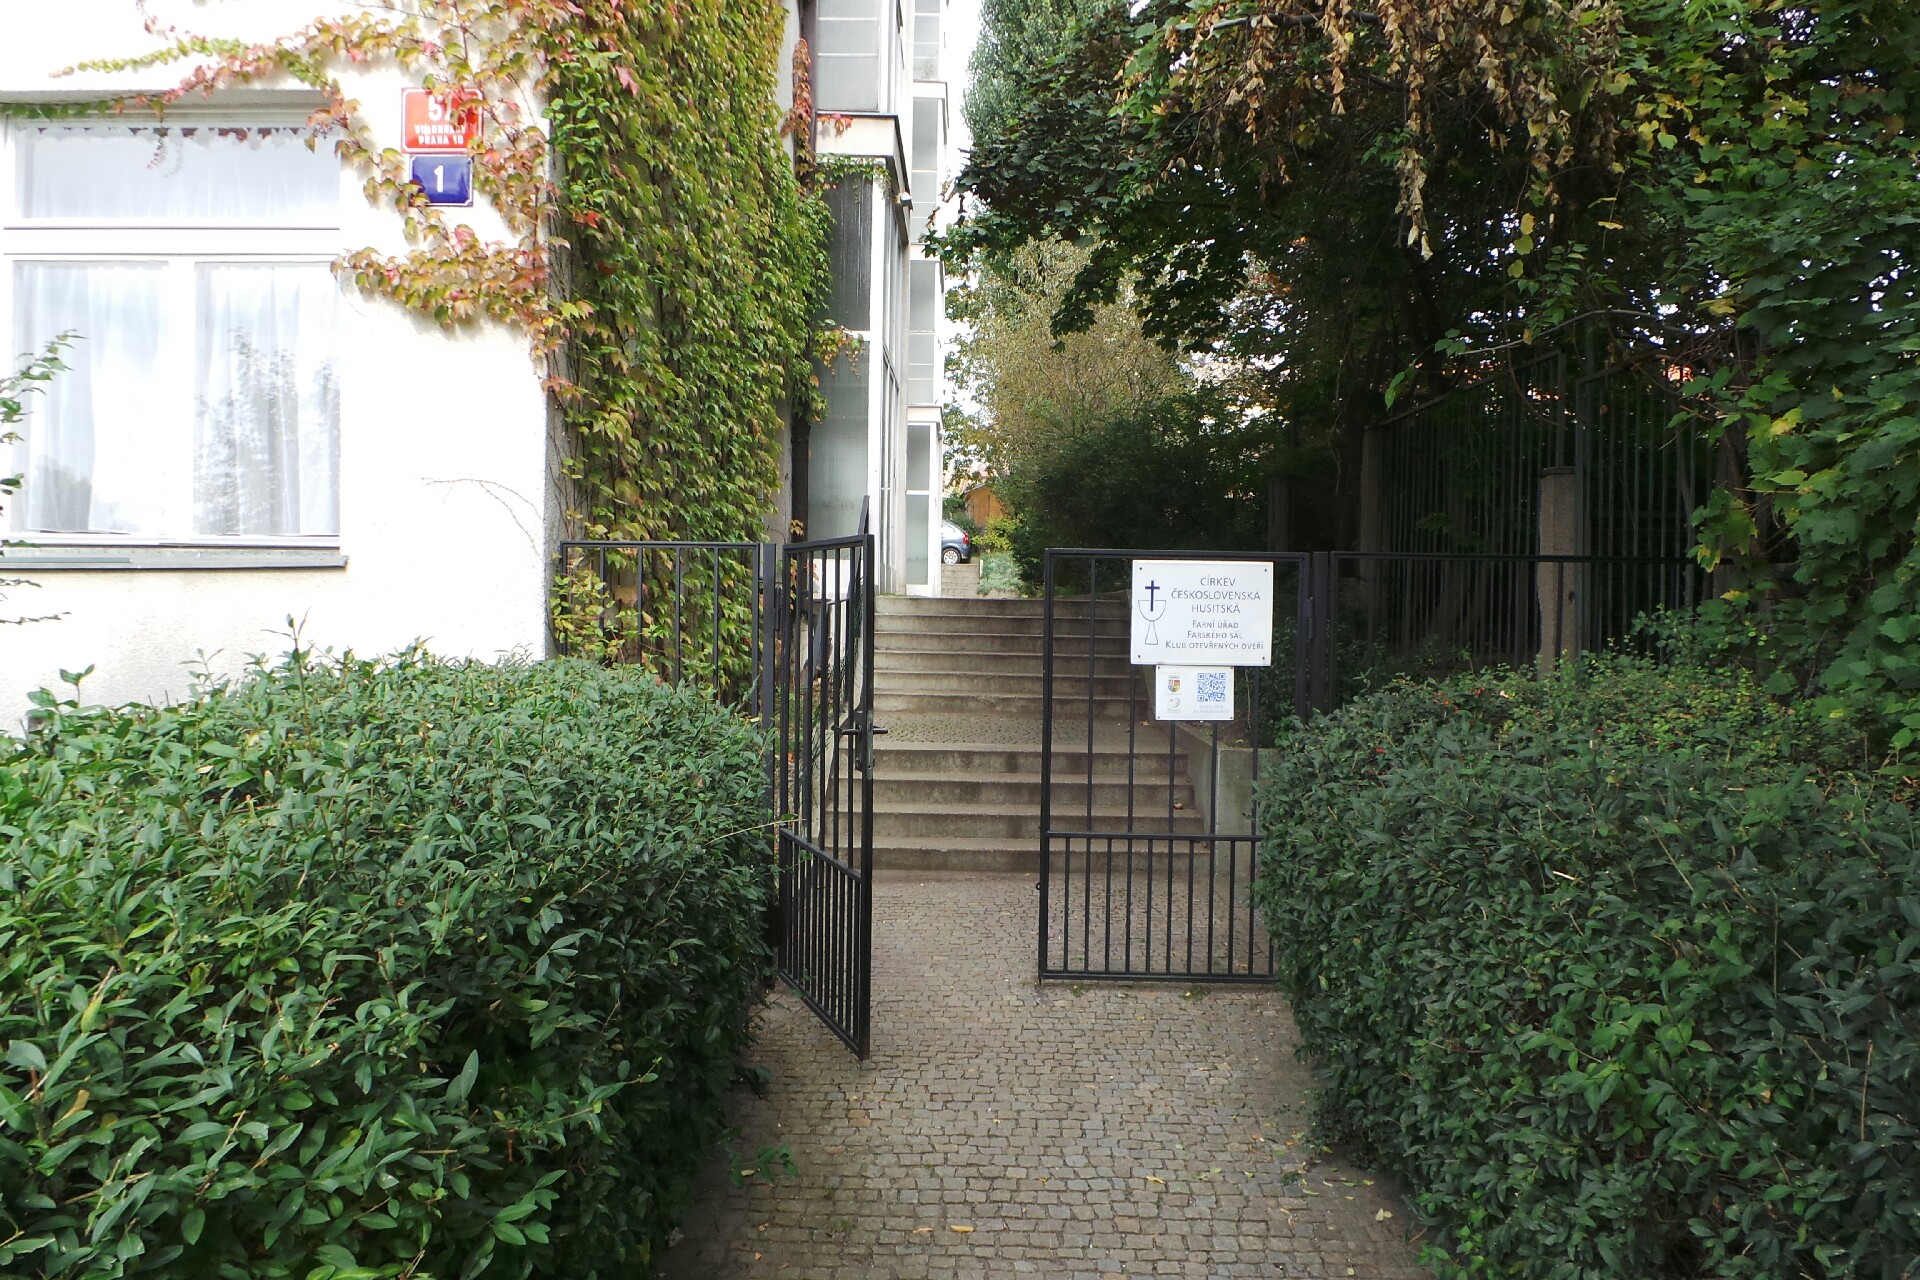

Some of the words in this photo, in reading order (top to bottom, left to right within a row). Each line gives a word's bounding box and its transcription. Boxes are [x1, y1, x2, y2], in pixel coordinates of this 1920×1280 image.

[418, 135, 450, 145] PRAHA
[453, 135, 464, 145] 10
[433, 165, 444, 193] 1
[1200, 575, 1236, 587] CÍRKEV
[1171, 588, 1261, 600] ČESKOSLOVENSKÁ
[1191, 603, 1241, 613] HUSITSKÁ
[1192, 620, 1215, 629] FARNÍ
[1217, 620, 1239, 629] ÚŘAD
[1187, 630, 1227, 639] FARSKÉHO
[1229, 631, 1243, 639] SÁL
[1165, 641, 1186, 649] KLUB
[1189, 641, 1239, 650] OTEVŘENÝCH
[1241, 641, 1264, 650] DVEŘÍ
